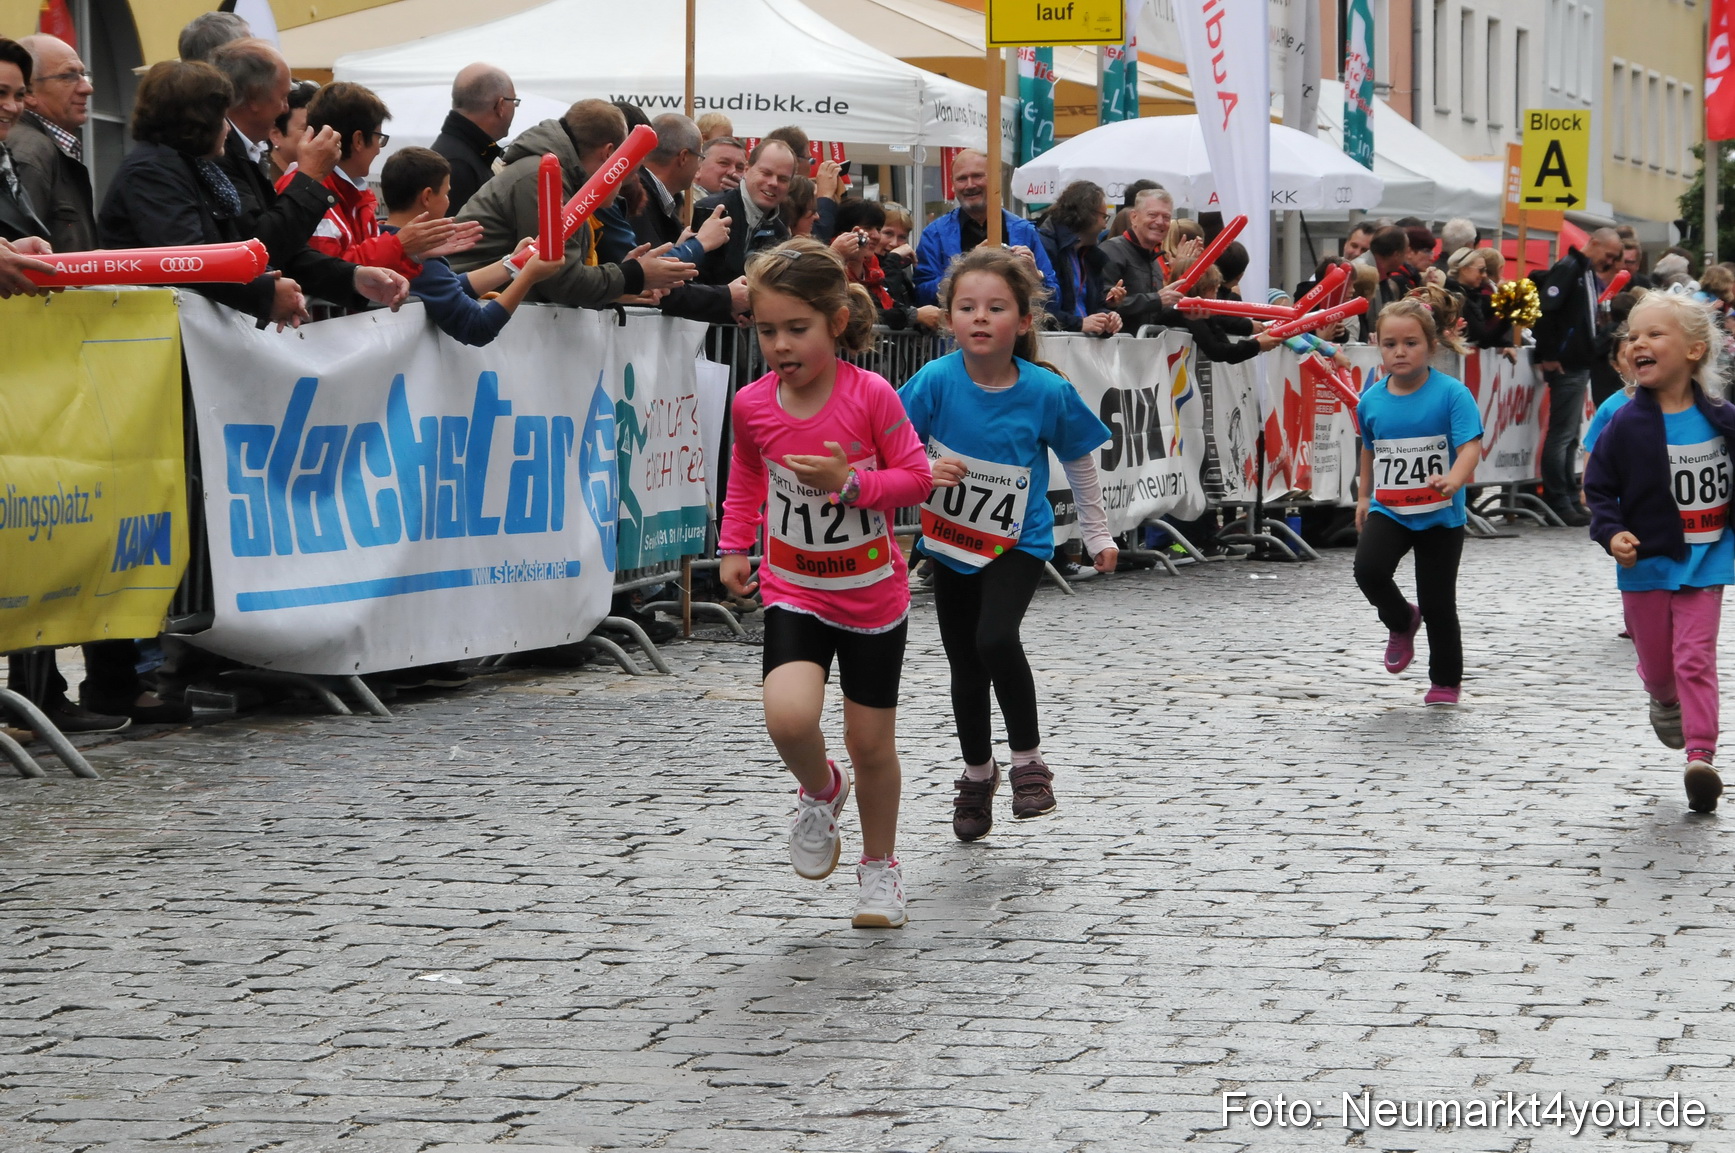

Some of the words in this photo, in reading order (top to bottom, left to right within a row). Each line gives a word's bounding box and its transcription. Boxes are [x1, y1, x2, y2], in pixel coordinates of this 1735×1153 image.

[1036, 2, 1074, 21] lauf
[609, 92, 850, 115] wwwaudibkk.de
[1531, 113, 1582, 131] Block
[1534, 140, 1572, 187] A
[575, 189, 600, 215] BKK
[55, 260, 98, 274] Audi
[104, 259, 143, 273] BKK
[1282, 327, 1301, 338] Audi
[1396, 444, 1434, 454] Neumarkt
[1679, 449, 1720, 465] Neumarkt
[964, 469, 1012, 487] eumarkt
[1379, 454, 1443, 485] 7246
[769, 469, 795, 494] PARTL
[1674, 462, 1729, 506] 085
[776, 490, 871, 545] 7121
[931, 519, 984, 551] Helene
[795, 553, 857, 577] Sophie
